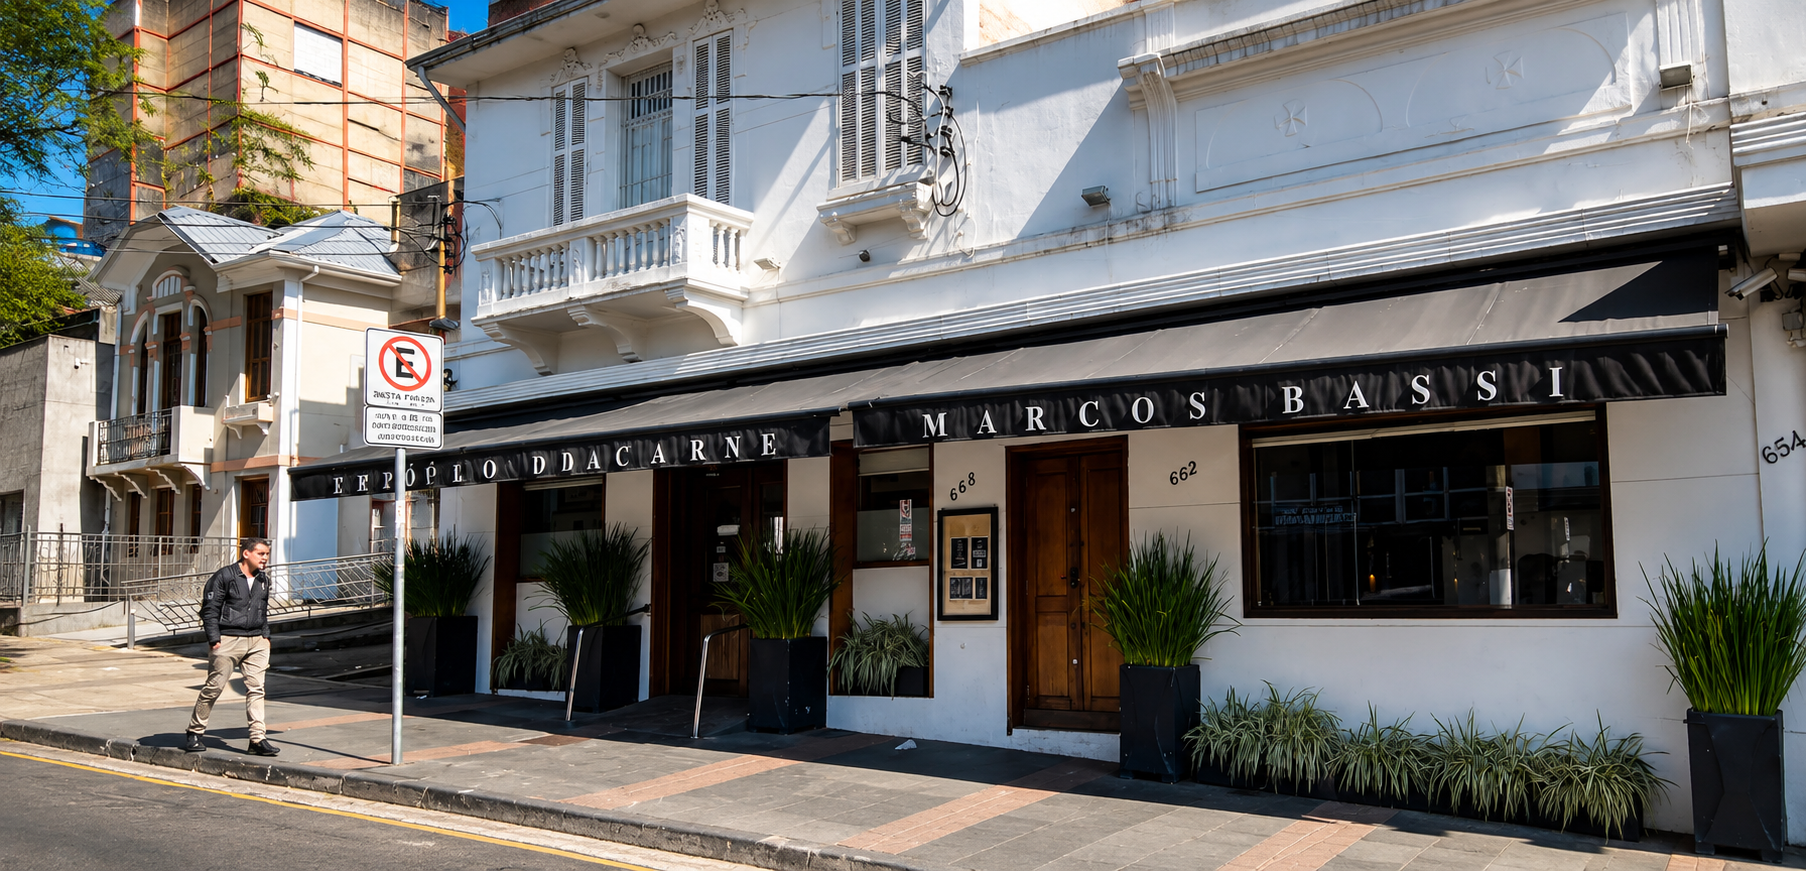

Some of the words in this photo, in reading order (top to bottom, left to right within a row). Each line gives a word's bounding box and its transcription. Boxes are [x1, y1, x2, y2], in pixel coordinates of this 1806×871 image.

[922, 392, 1206, 439] MARCOS
[1281, 366, 1563, 414] BASSI
[1762, 429, 1806, 464] 654
[949, 472, 976, 501] 668
[1169, 460, 1198, 486] 662
